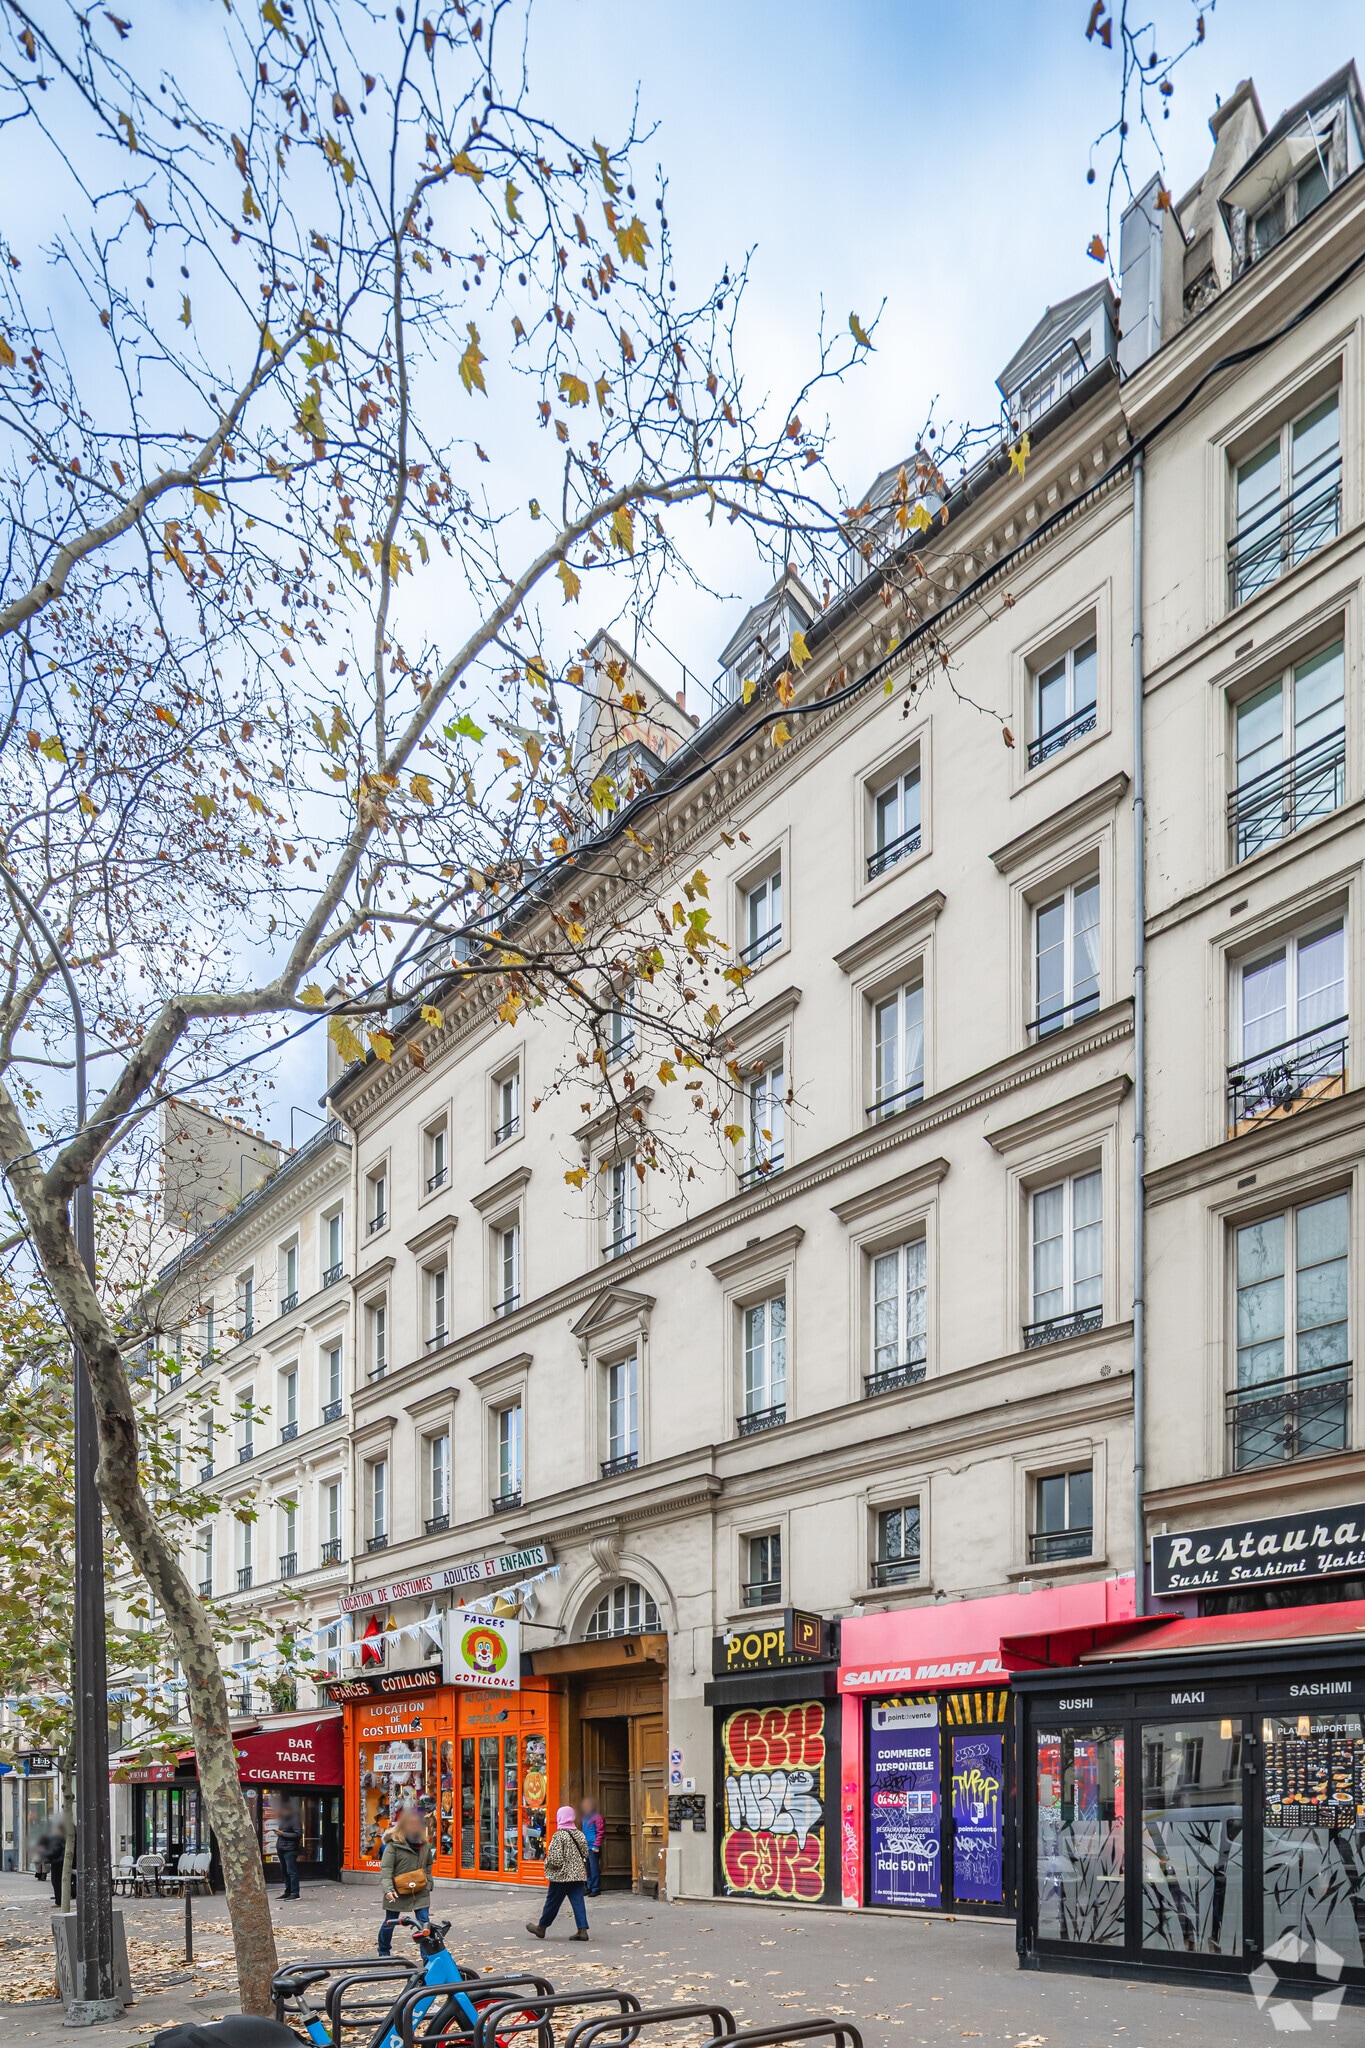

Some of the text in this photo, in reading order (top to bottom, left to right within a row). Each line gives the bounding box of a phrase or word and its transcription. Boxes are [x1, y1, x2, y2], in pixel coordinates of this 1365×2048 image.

[1168, 1522, 1365, 1569] Restaura
[1168, 1550, 1365, 1588] Sushi Sashimi Yaki
[341, 1548, 544, 1611] LOCATION DE COSTUMES ADULTES ET ENFANTS
[464, 1614, 505, 1628] FARCES
[727, 1662, 759, 1671] SMASH
[454, 1674, 516, 1687] COTILLONS
[843, 1667, 912, 1686] SANTA
[335, 1671, 437, 1699] FARCES COTILLONS
[1289, 1681, 1352, 1696] SASHIMI
[465, 1692, 474, 1702] AU
[476, 1691, 500, 1702] CLOWN
[1171, 1691, 1205, 1705] MAKI
[370, 1702, 425, 1716] LOCATION
[484, 1703, 492, 1712] LA
[1059, 1698, 1093, 1710] SUSHI
[887, 1713, 932, 1722] pointdevente
[362, 1723, 423, 1737] COSTUMES
[1310, 1723, 1361, 1734] EMPORTER
[288, 1739, 312, 1749] BAR
[276, 1752, 315, 1763] TABAC
[877, 1748, 932, 1759] COMMERCE
[875, 1761, 934, 1772] DISPONIBLE
[249, 1769, 316, 1781] CIGARETTE
[878, 1859, 899, 1871] Rdc
[901, 1860, 916, 1871] 50
